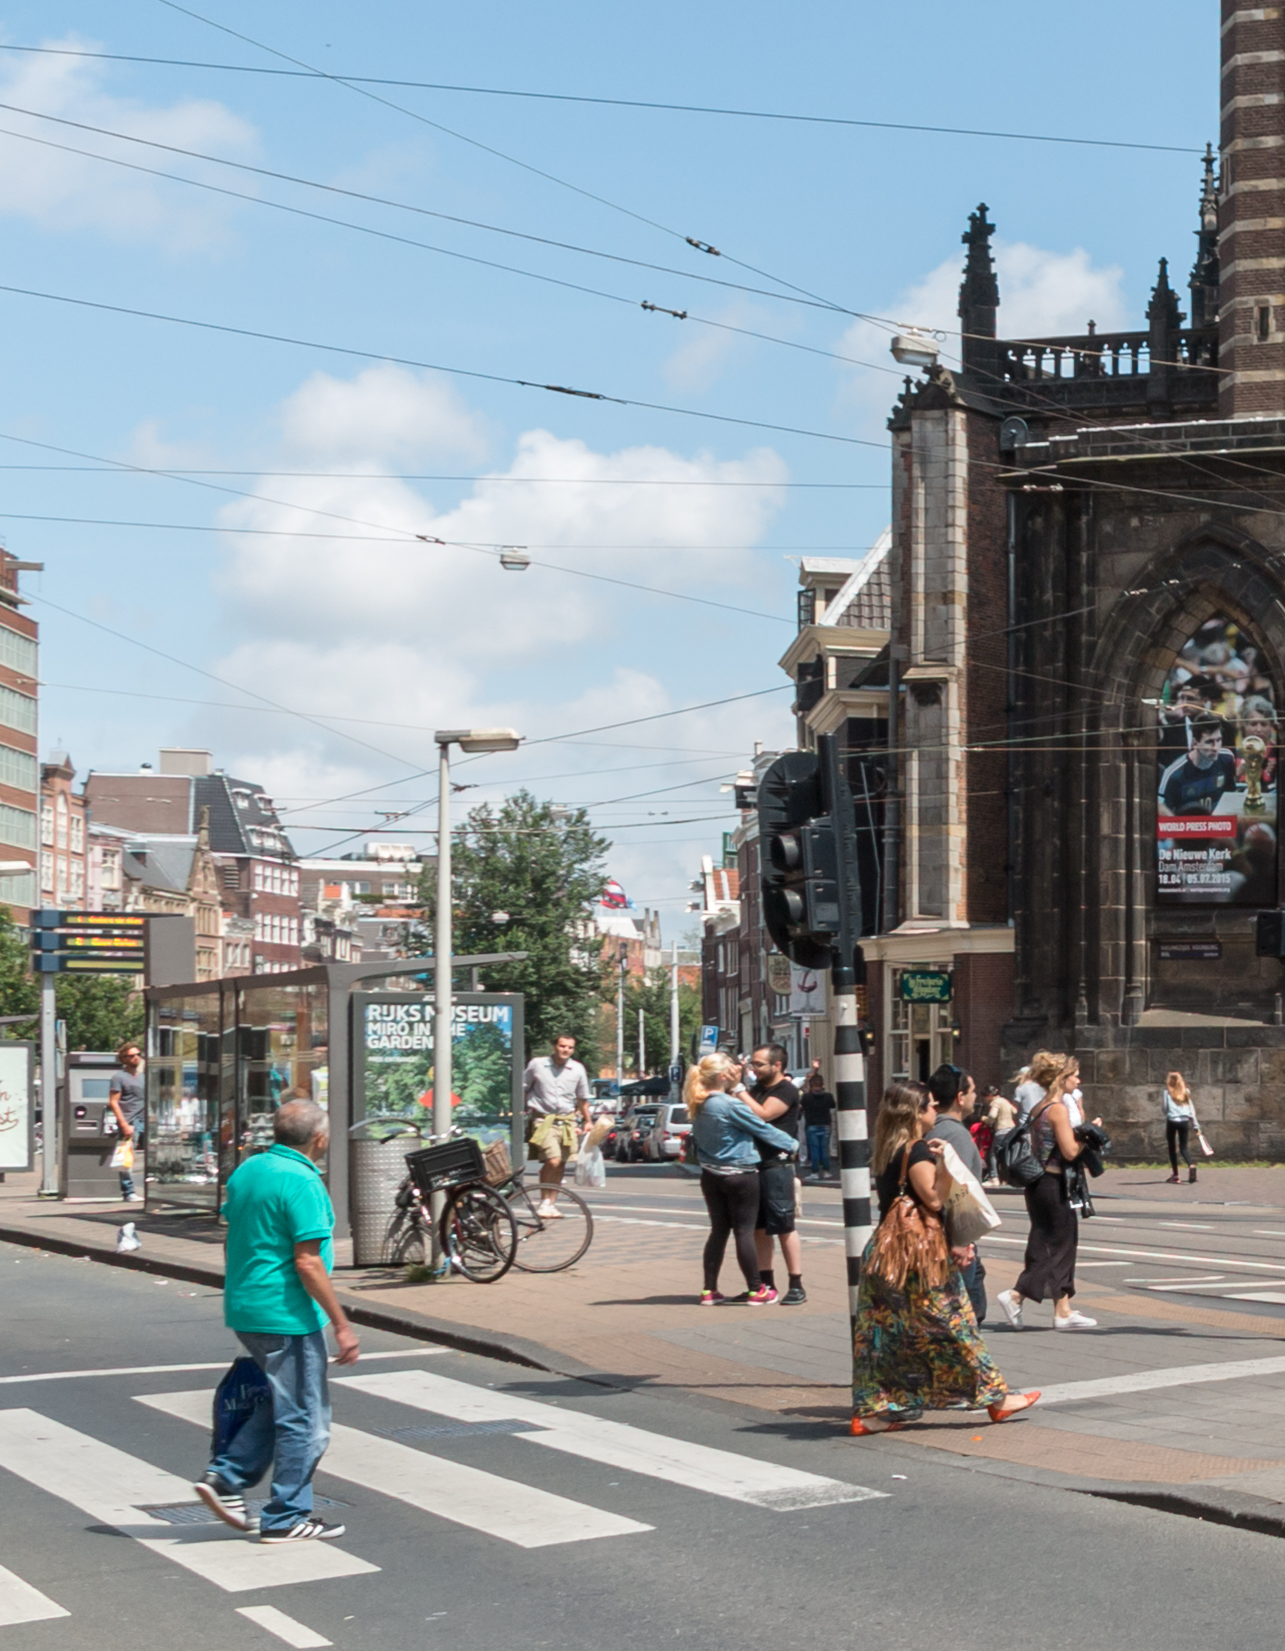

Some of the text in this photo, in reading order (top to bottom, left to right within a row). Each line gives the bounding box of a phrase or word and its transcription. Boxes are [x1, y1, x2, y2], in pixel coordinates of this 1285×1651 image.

[1158, 822, 1185, 832] WORLD
[1186, 821, 1207, 831] PRESS
[1208, 821, 1232, 831] PHOTO
[1158, 847, 1232, 860] De Nieuwe Kerk
[1158, 860, 1223, 872] Dam Amsterdam
[1158, 873, 1231, 884] 18.04 05.07.2015
[425, 1005, 509, 1022] MSEUM
[367, 1020, 466, 1036] MIRÓ IN HE
[704, 1027, 714, 1039] P
[367, 1036, 434, 1049] GARDEN
